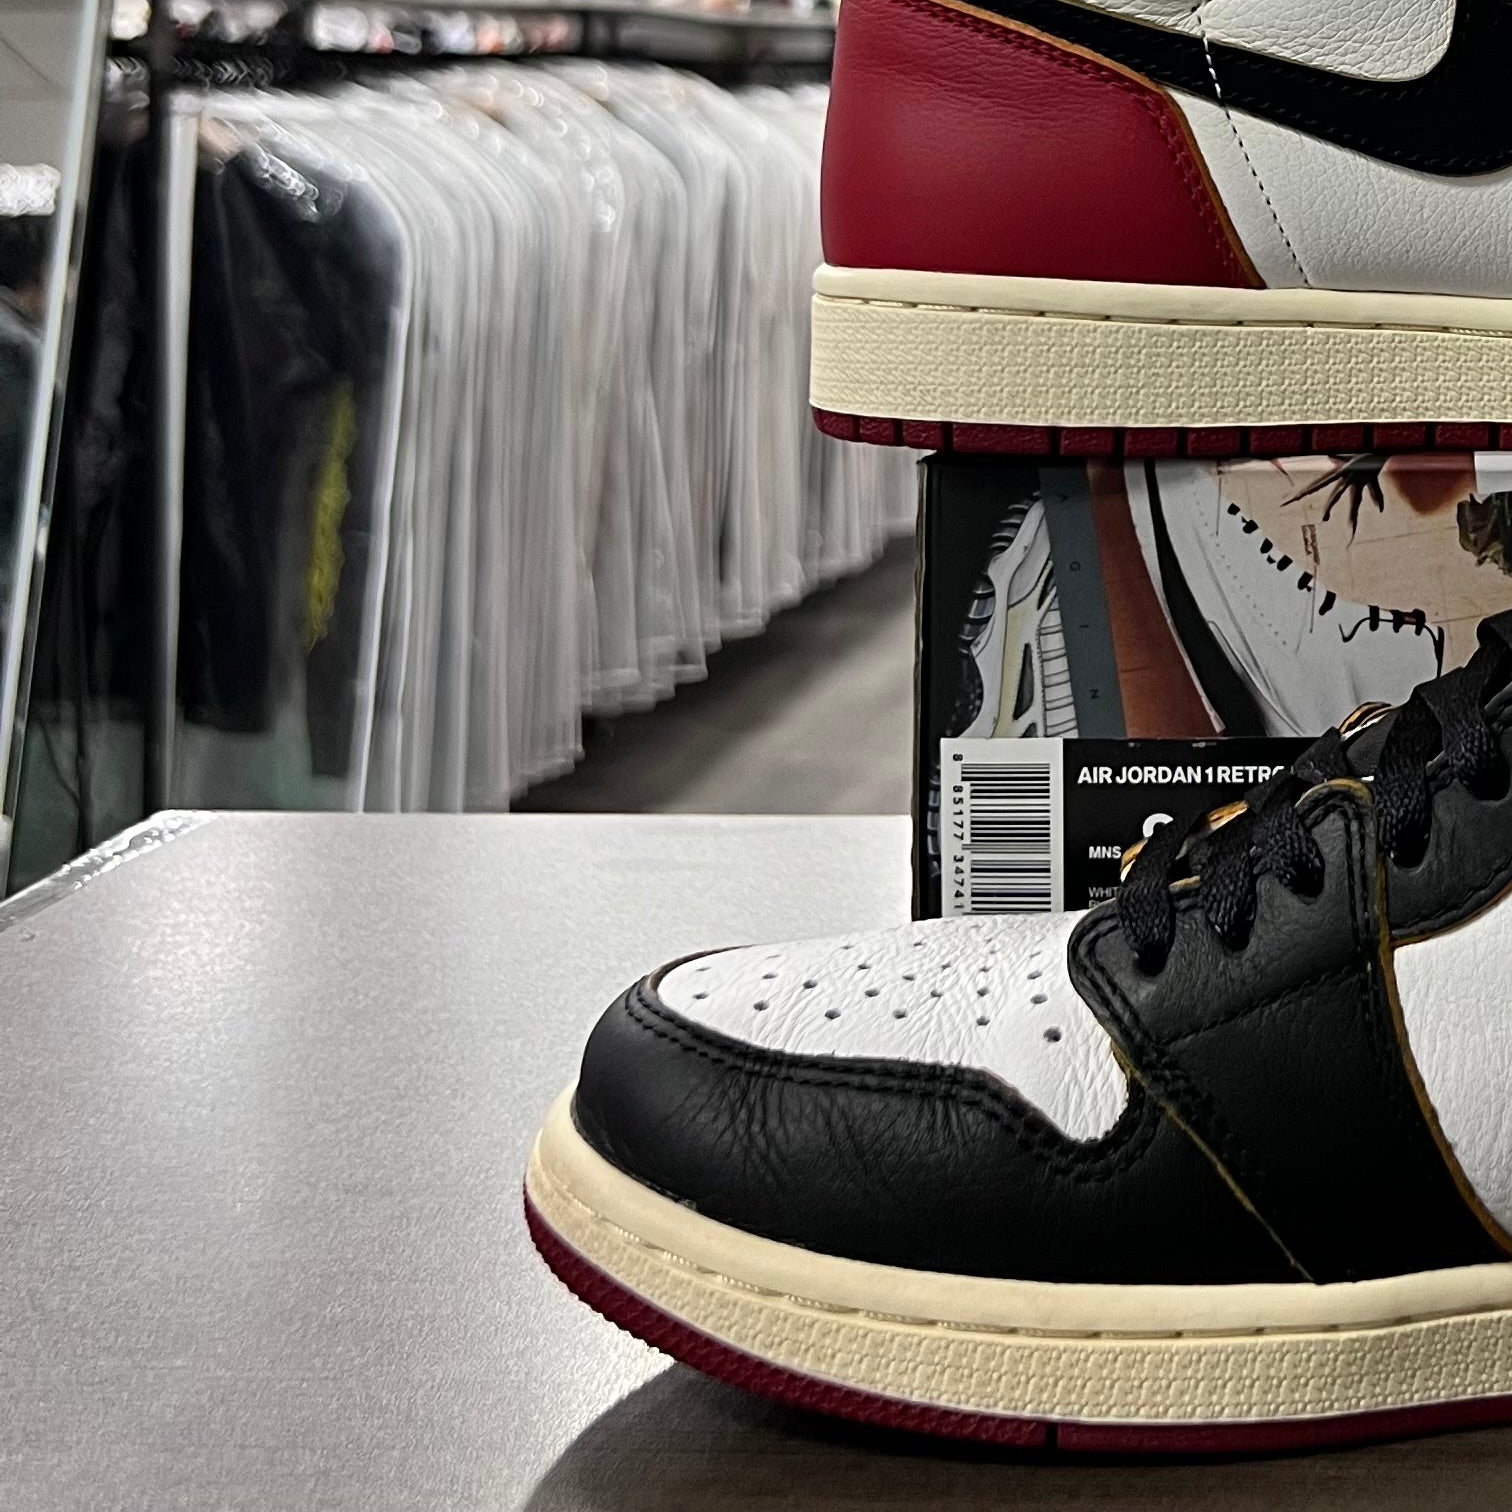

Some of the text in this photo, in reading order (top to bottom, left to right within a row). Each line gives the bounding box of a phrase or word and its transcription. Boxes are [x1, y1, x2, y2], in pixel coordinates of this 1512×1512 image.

[1077, 766, 1113, 784] AIR
[1115, 765, 1202, 785] JORDAN
[1204, 766, 1214, 784] 1
[952, 753, 965, 909] 8 85177 34741
[1088, 845, 1122, 860] MNS
